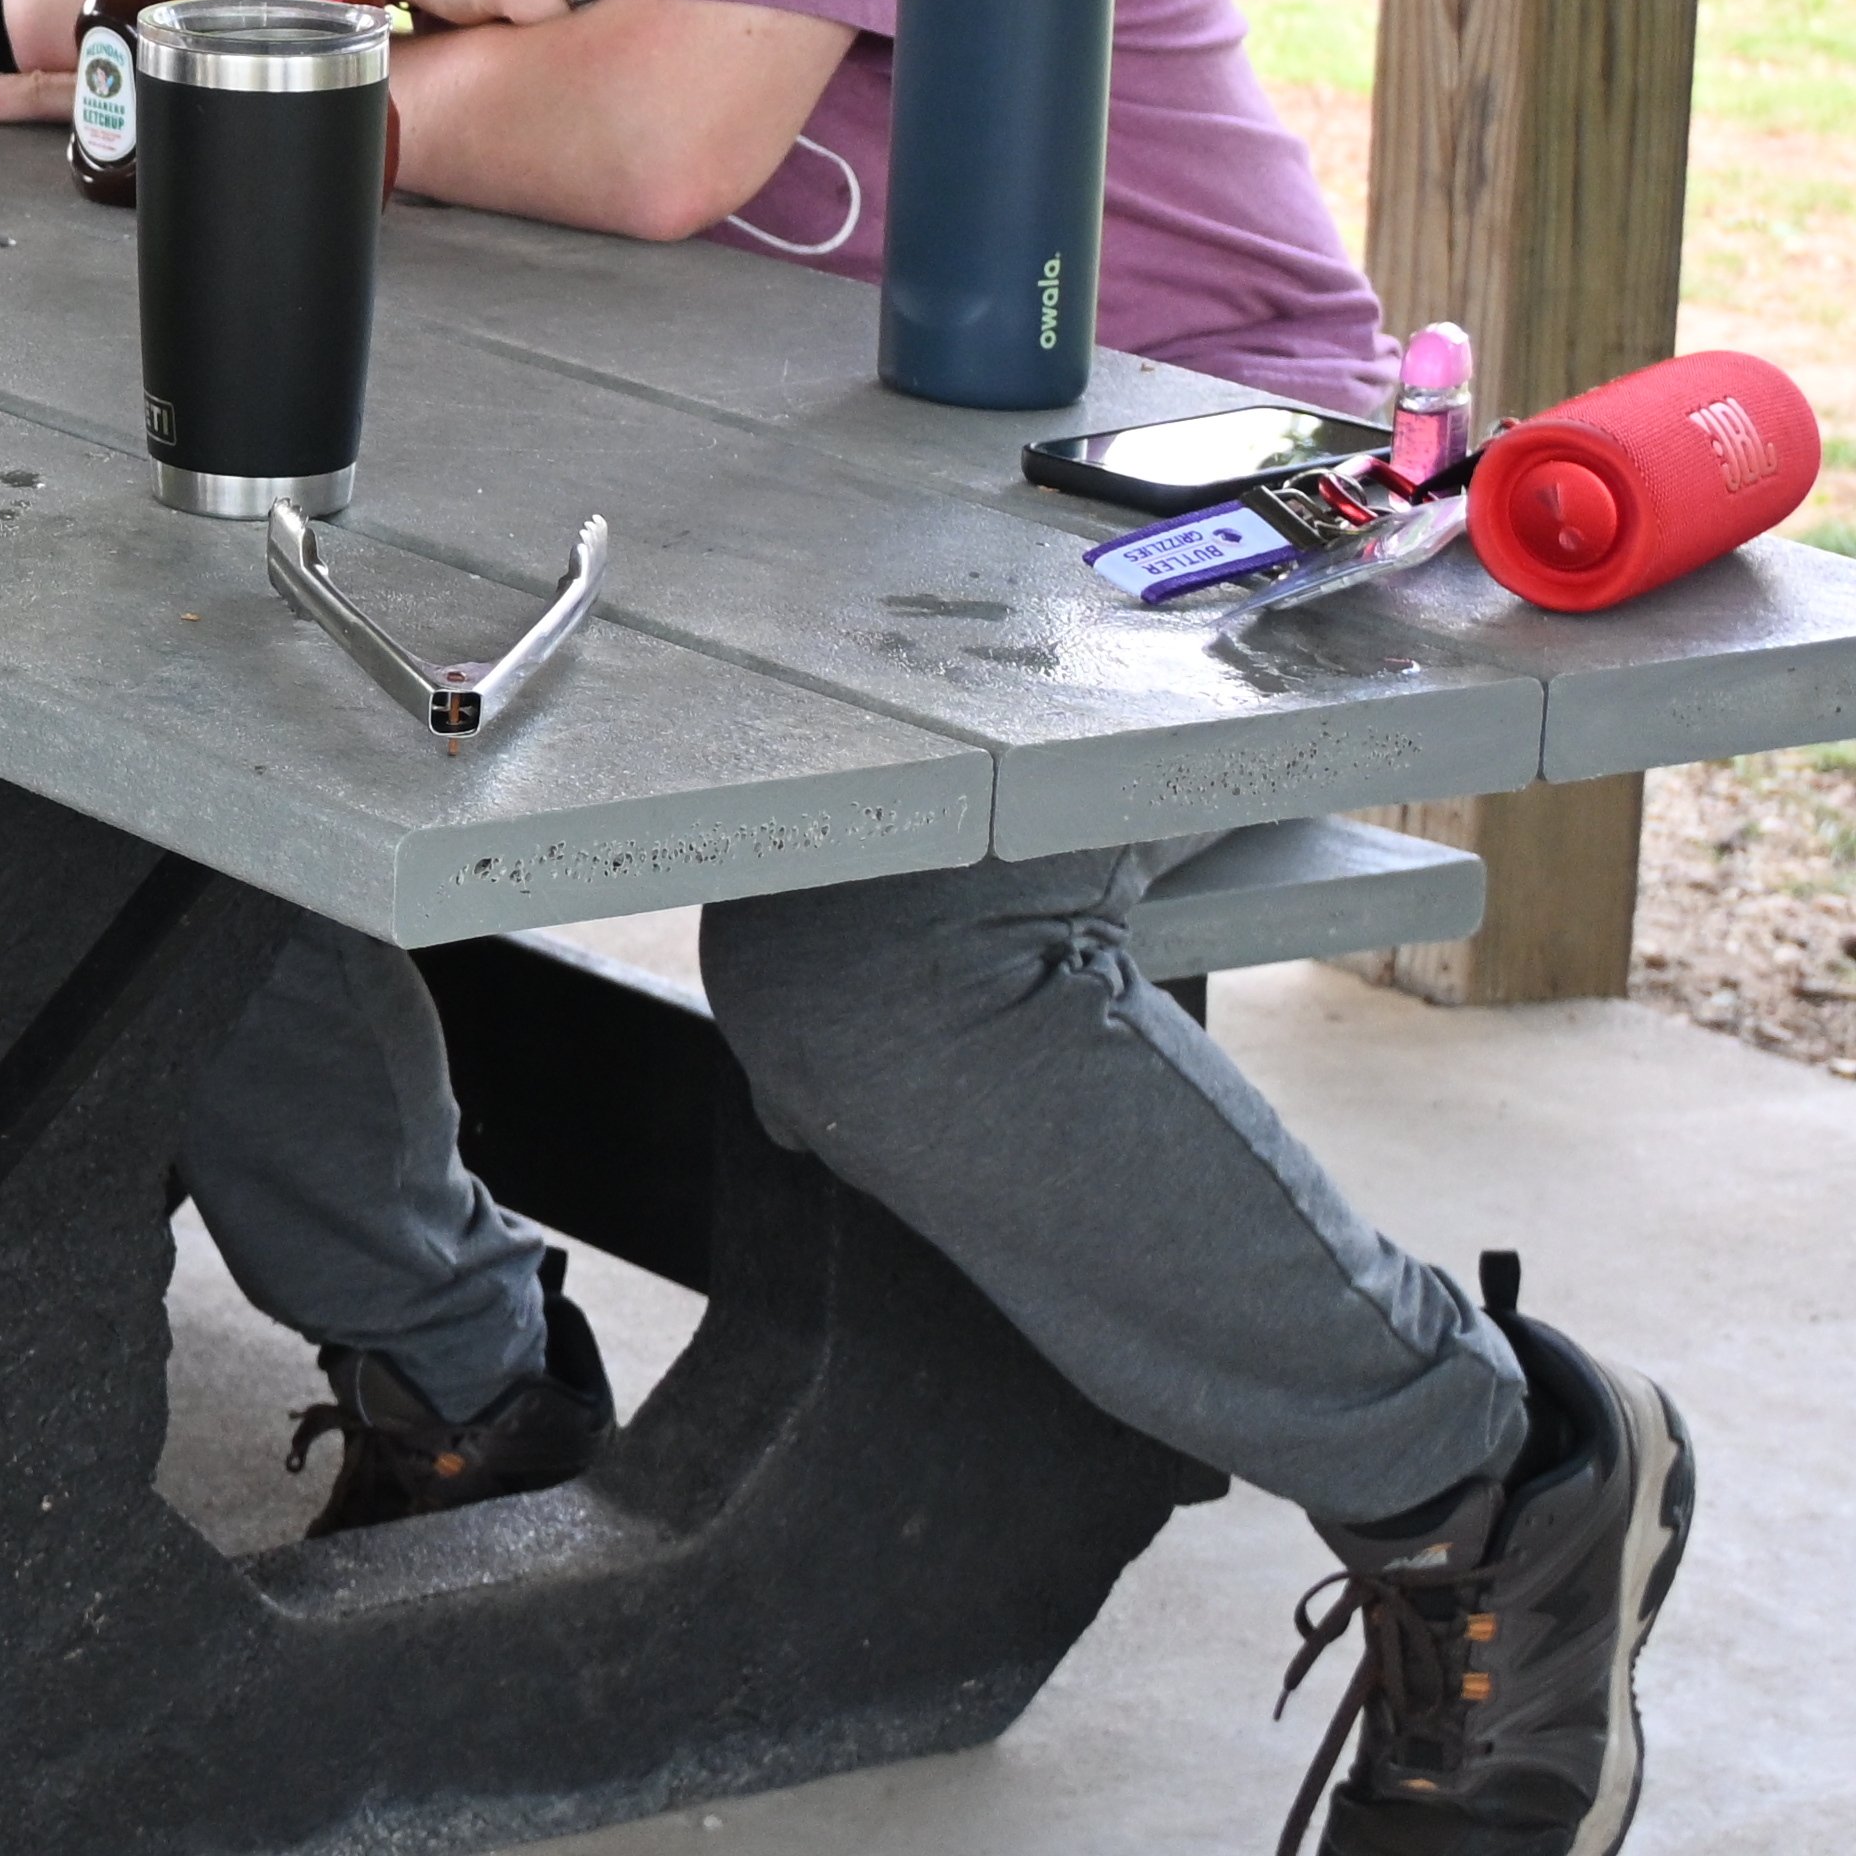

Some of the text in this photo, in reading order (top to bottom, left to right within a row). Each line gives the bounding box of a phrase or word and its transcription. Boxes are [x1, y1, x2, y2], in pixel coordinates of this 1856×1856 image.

[82, 109, 126, 131] KETCHUP
[1037, 258, 1061, 350] owala
[1690, 395, 1778, 493] JBL
[1122, 529, 1204, 562] GRIZZLIES
[1140, 544, 1224, 576] BUTLER
